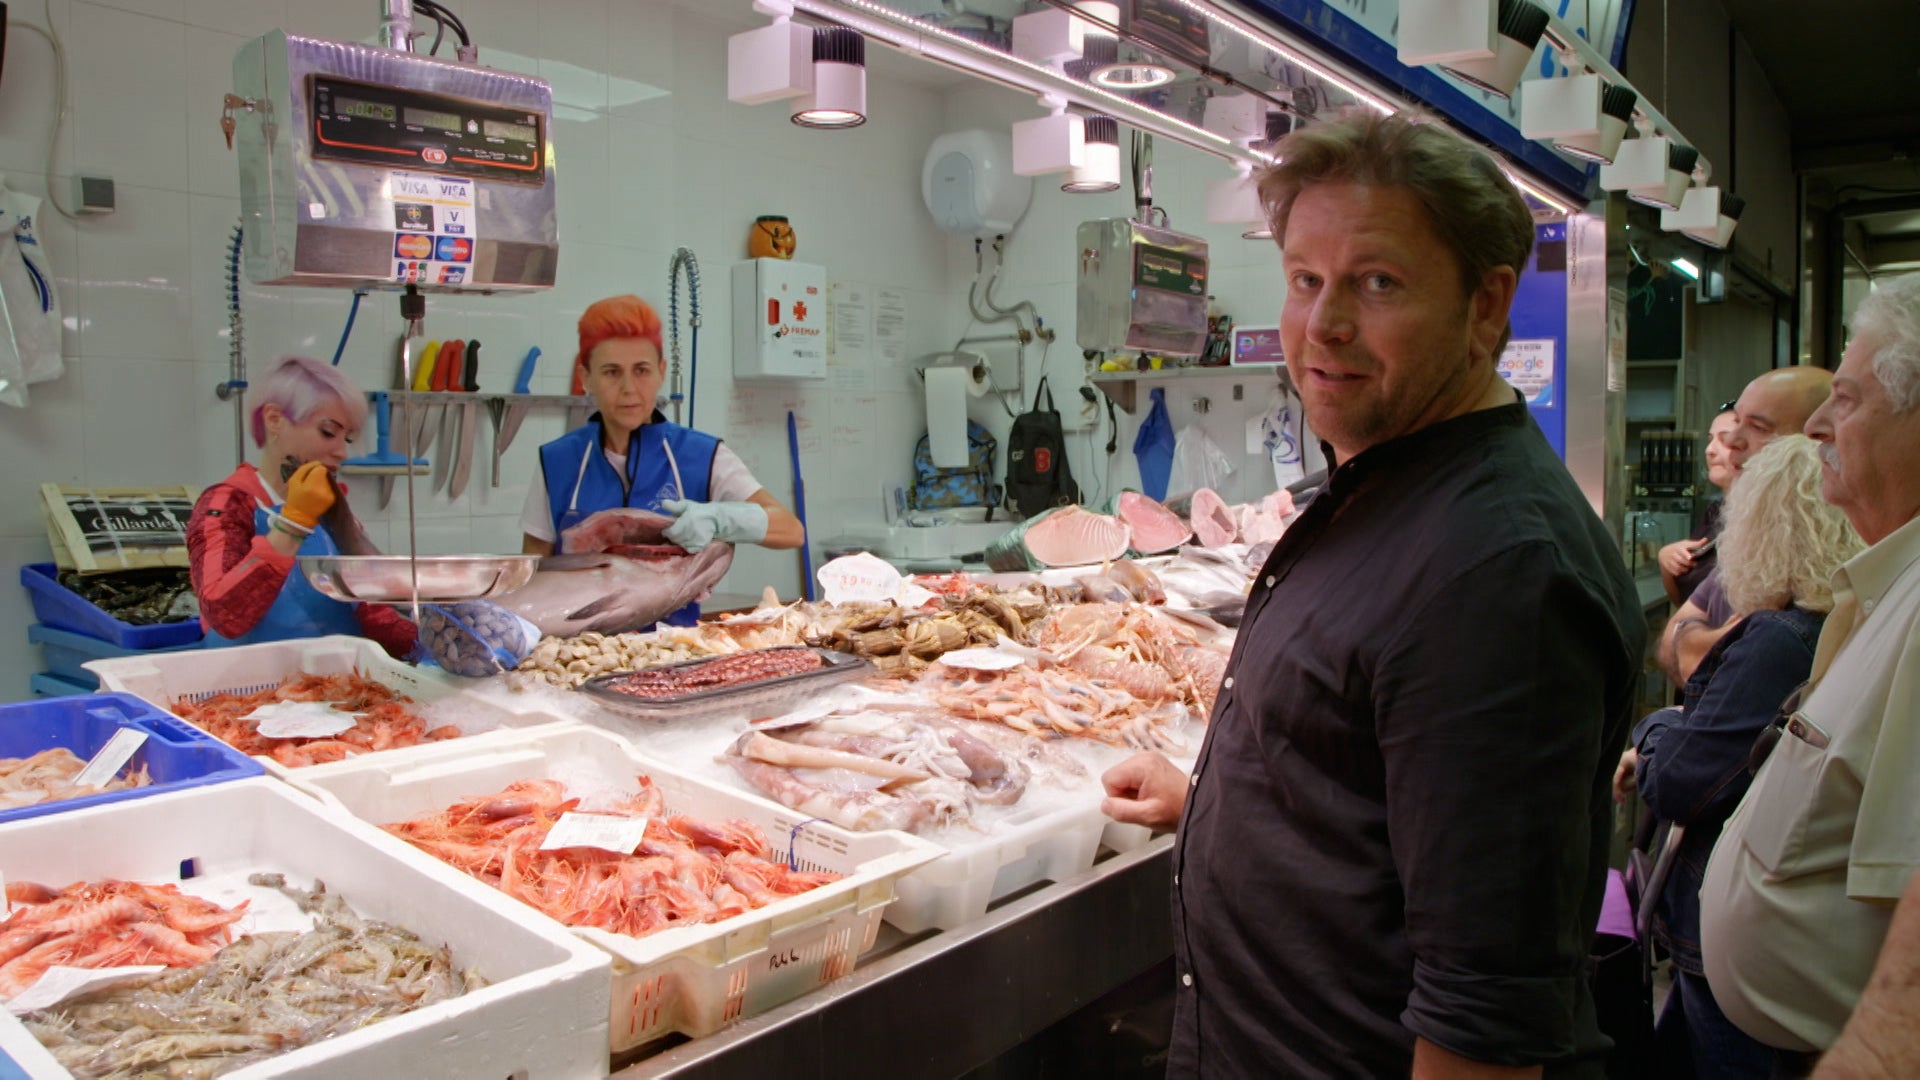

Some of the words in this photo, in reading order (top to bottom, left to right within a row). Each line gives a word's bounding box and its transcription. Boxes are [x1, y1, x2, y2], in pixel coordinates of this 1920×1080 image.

[399, 180, 429, 195] VISA
[440, 184, 467, 198] VISA
[449, 211, 459, 222] V
[440, 245, 468, 254] Maestro
[791, 326, 820, 337] FREMAP
[1035, 447, 1051, 473] B
[91, 515, 188, 531] Gillarde
